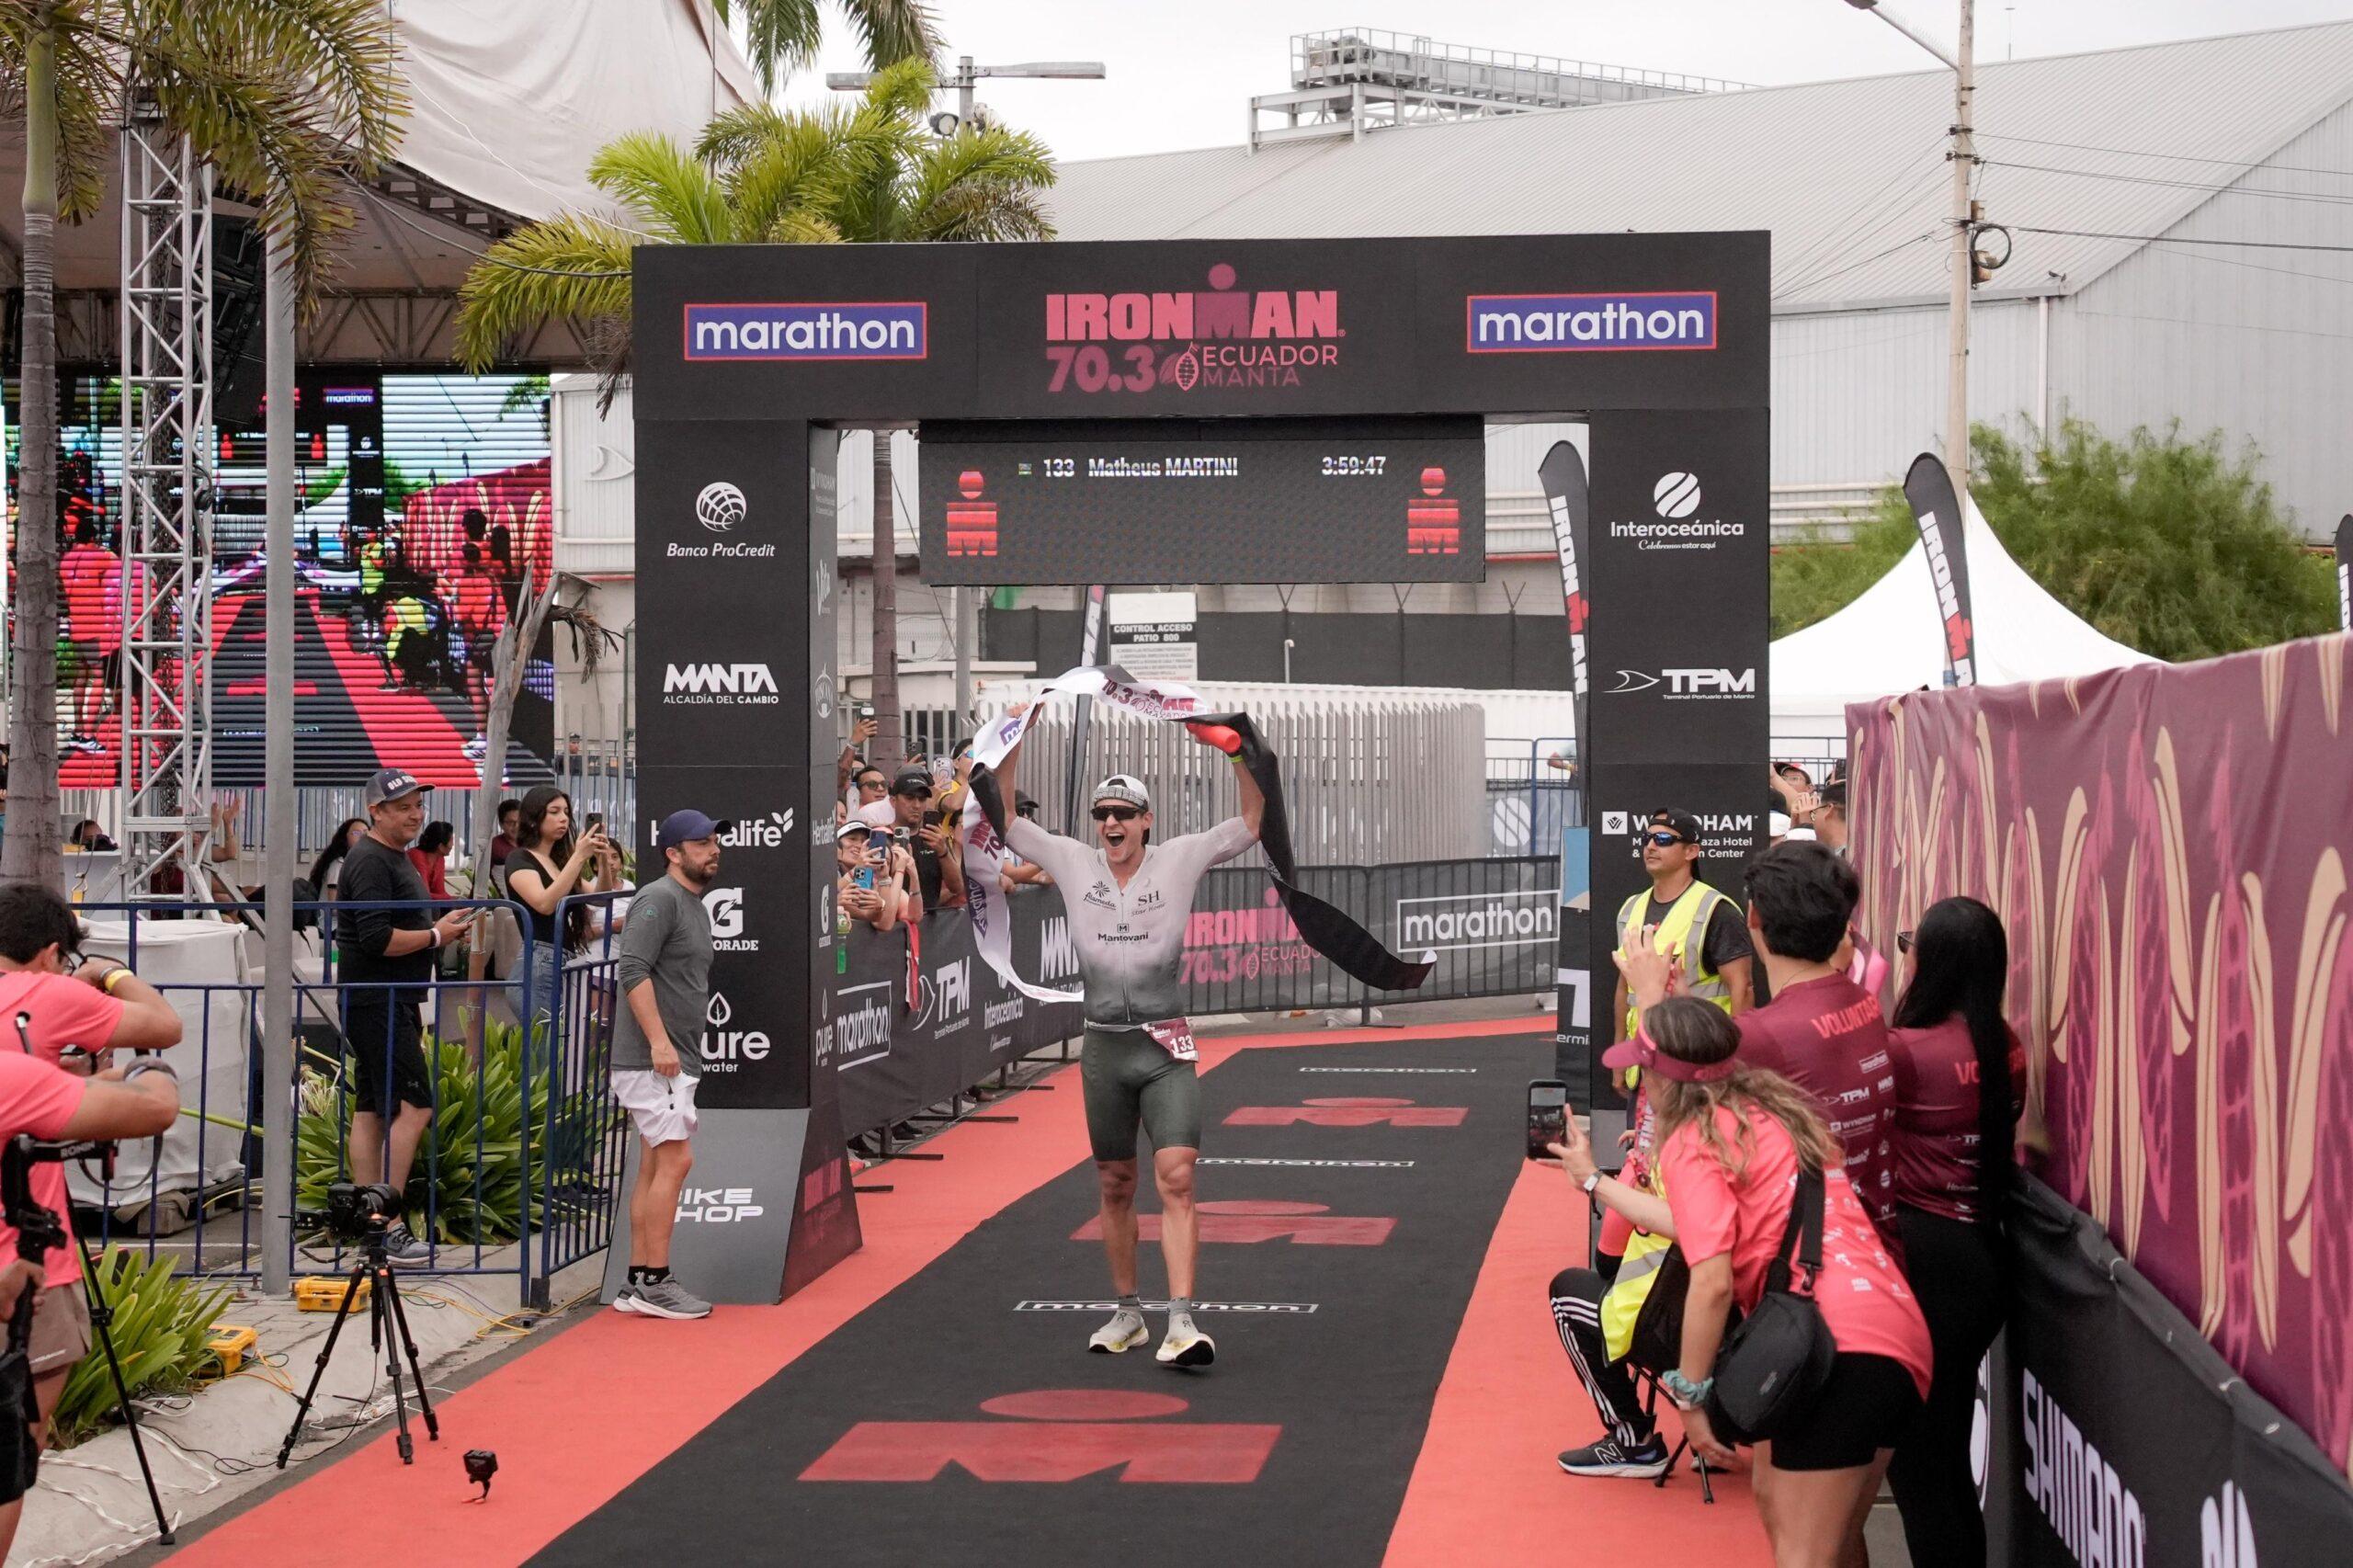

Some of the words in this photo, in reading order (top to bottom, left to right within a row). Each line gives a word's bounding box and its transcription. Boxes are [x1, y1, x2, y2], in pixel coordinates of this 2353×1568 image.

[696, 312, 915, 350] marathon
[1479, 303, 1704, 342] marathon
[1202, 346, 1338, 366] ECUADOR
[1046, 345, 1155, 392] 70.3
[1203, 367, 1301, 387] MANTA
[1043, 459, 1074, 477] 133
[1088, 457, 1161, 476] Matheus
[1165, 457, 1238, 476] MARTINI
[1322, 456, 1386, 476] 3:59:47
[1611, 519, 1744, 537] Interoceánica
[666, 542, 709, 557] Banco
[711, 541, 776, 558] ProCredit
[1700, 541, 1716, 550] aquí
[1114, 624, 1155, 632] CONTROL
[1157, 623, 1193, 632] ACCESO
[1133, 634, 1159, 642] PATIO
[1164, 633, 1179, 642] 800
[664, 663, 779, 694] MANTA
[1662, 668, 1755, 693] TPM
[664, 693, 713, 704] ALCALDÍA
[716, 695, 735, 704] DEL
[737, 695, 779, 704] CAMBIO
[1632, 814, 1753, 831] WHAM
[651, 819, 781, 846] alife
[1701, 836, 1720, 846] aza
[1723, 836, 1752, 846] Hotel
[1632, 849, 1640, 858] &
[1708, 849, 1745, 858] Center
[1138, 891, 1160, 907] SH
[1405, 902, 1552, 942] marathon
[712, 940, 758, 950] ORADE
[1097, 932, 1149, 942] Mantovani
[1261, 944, 1321, 961] ECUADO
[1179, 949, 1238, 984] 70.3
[937, 956, 970, 1023] TPM
[837, 997, 888, 1054] marathon
[700, 1031, 770, 1060] ure
[815, 1024, 833, 1066] pure
[1170, 1035, 1194, 1053] 133
[701, 1061, 738, 1073] water
[1840, 1087, 1870, 1103] TPM
[682, 1188, 753, 1204] IKE
[674, 1206, 764, 1222] HOP
